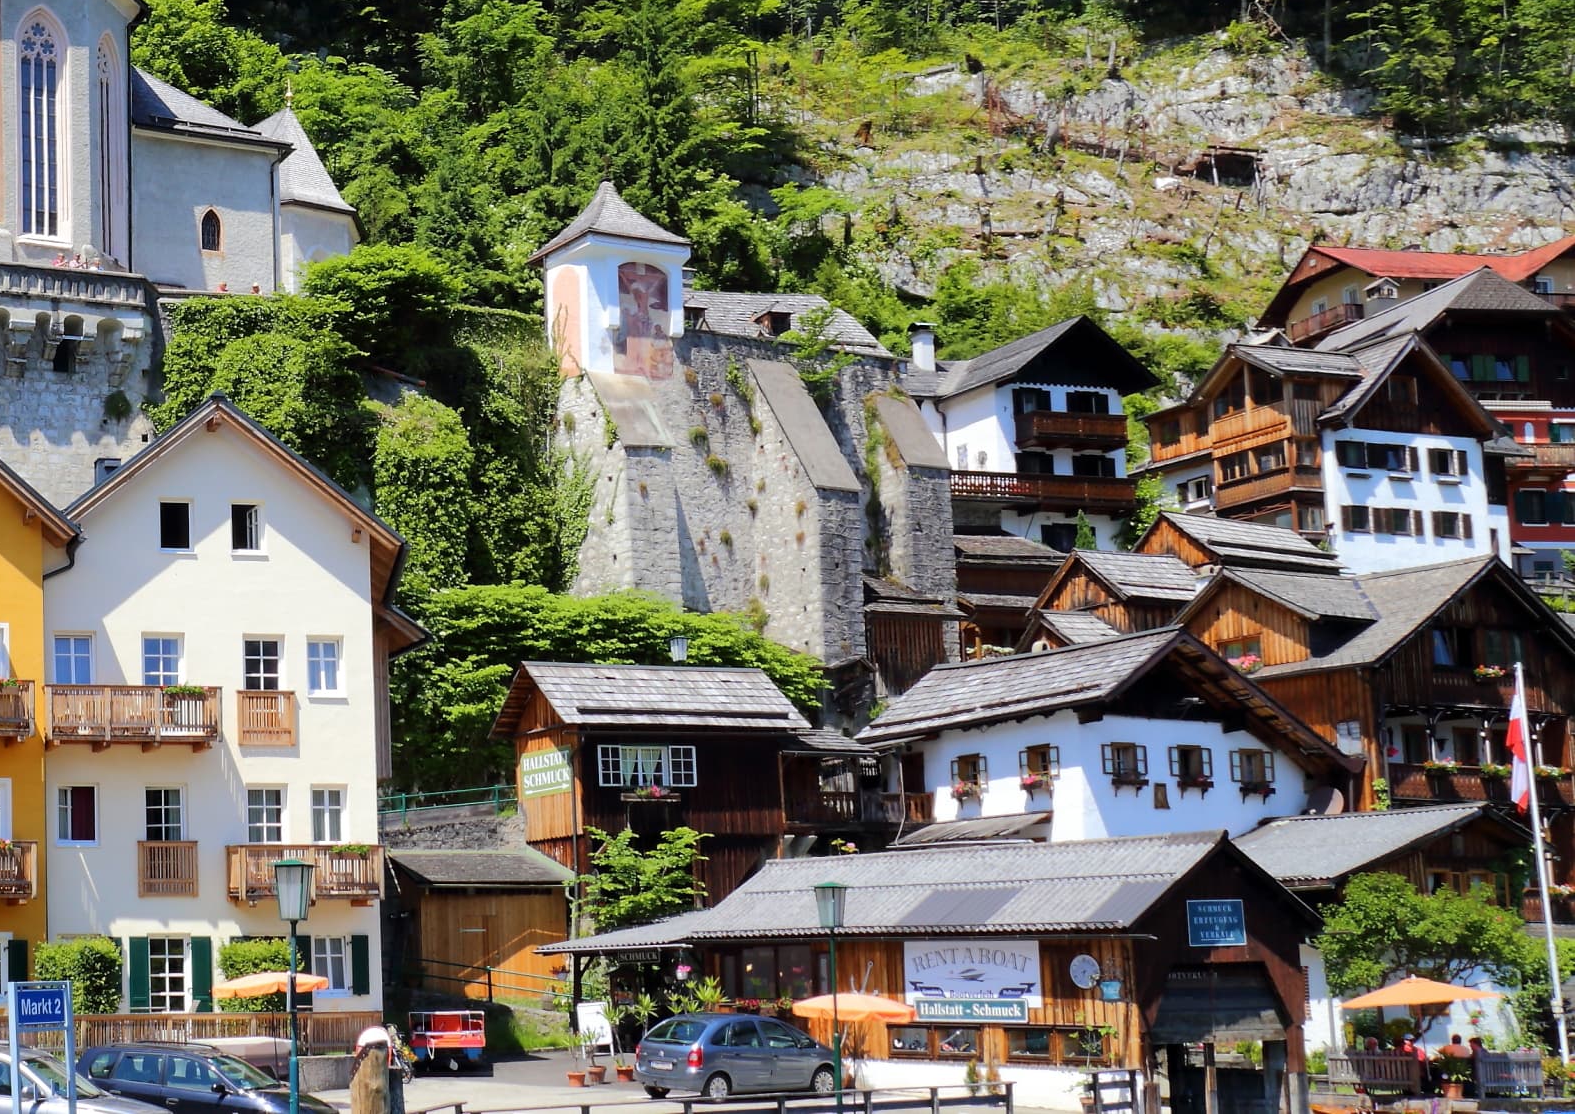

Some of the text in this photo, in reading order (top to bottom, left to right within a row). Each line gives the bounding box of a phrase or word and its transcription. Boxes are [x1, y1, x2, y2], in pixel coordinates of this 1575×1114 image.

[523, 750, 570, 771] HALLSTATT
[523, 767, 571, 788] SCHMUCK
[619, 951, 658, 961] SCHMUCK
[912, 947, 1032, 973] RENT A BOAT
[21, 997, 61, 1015] Markt 2
[920, 1002, 963, 1016] Hallstatt
[972, 1003, 1022, 1017] Schmuck
